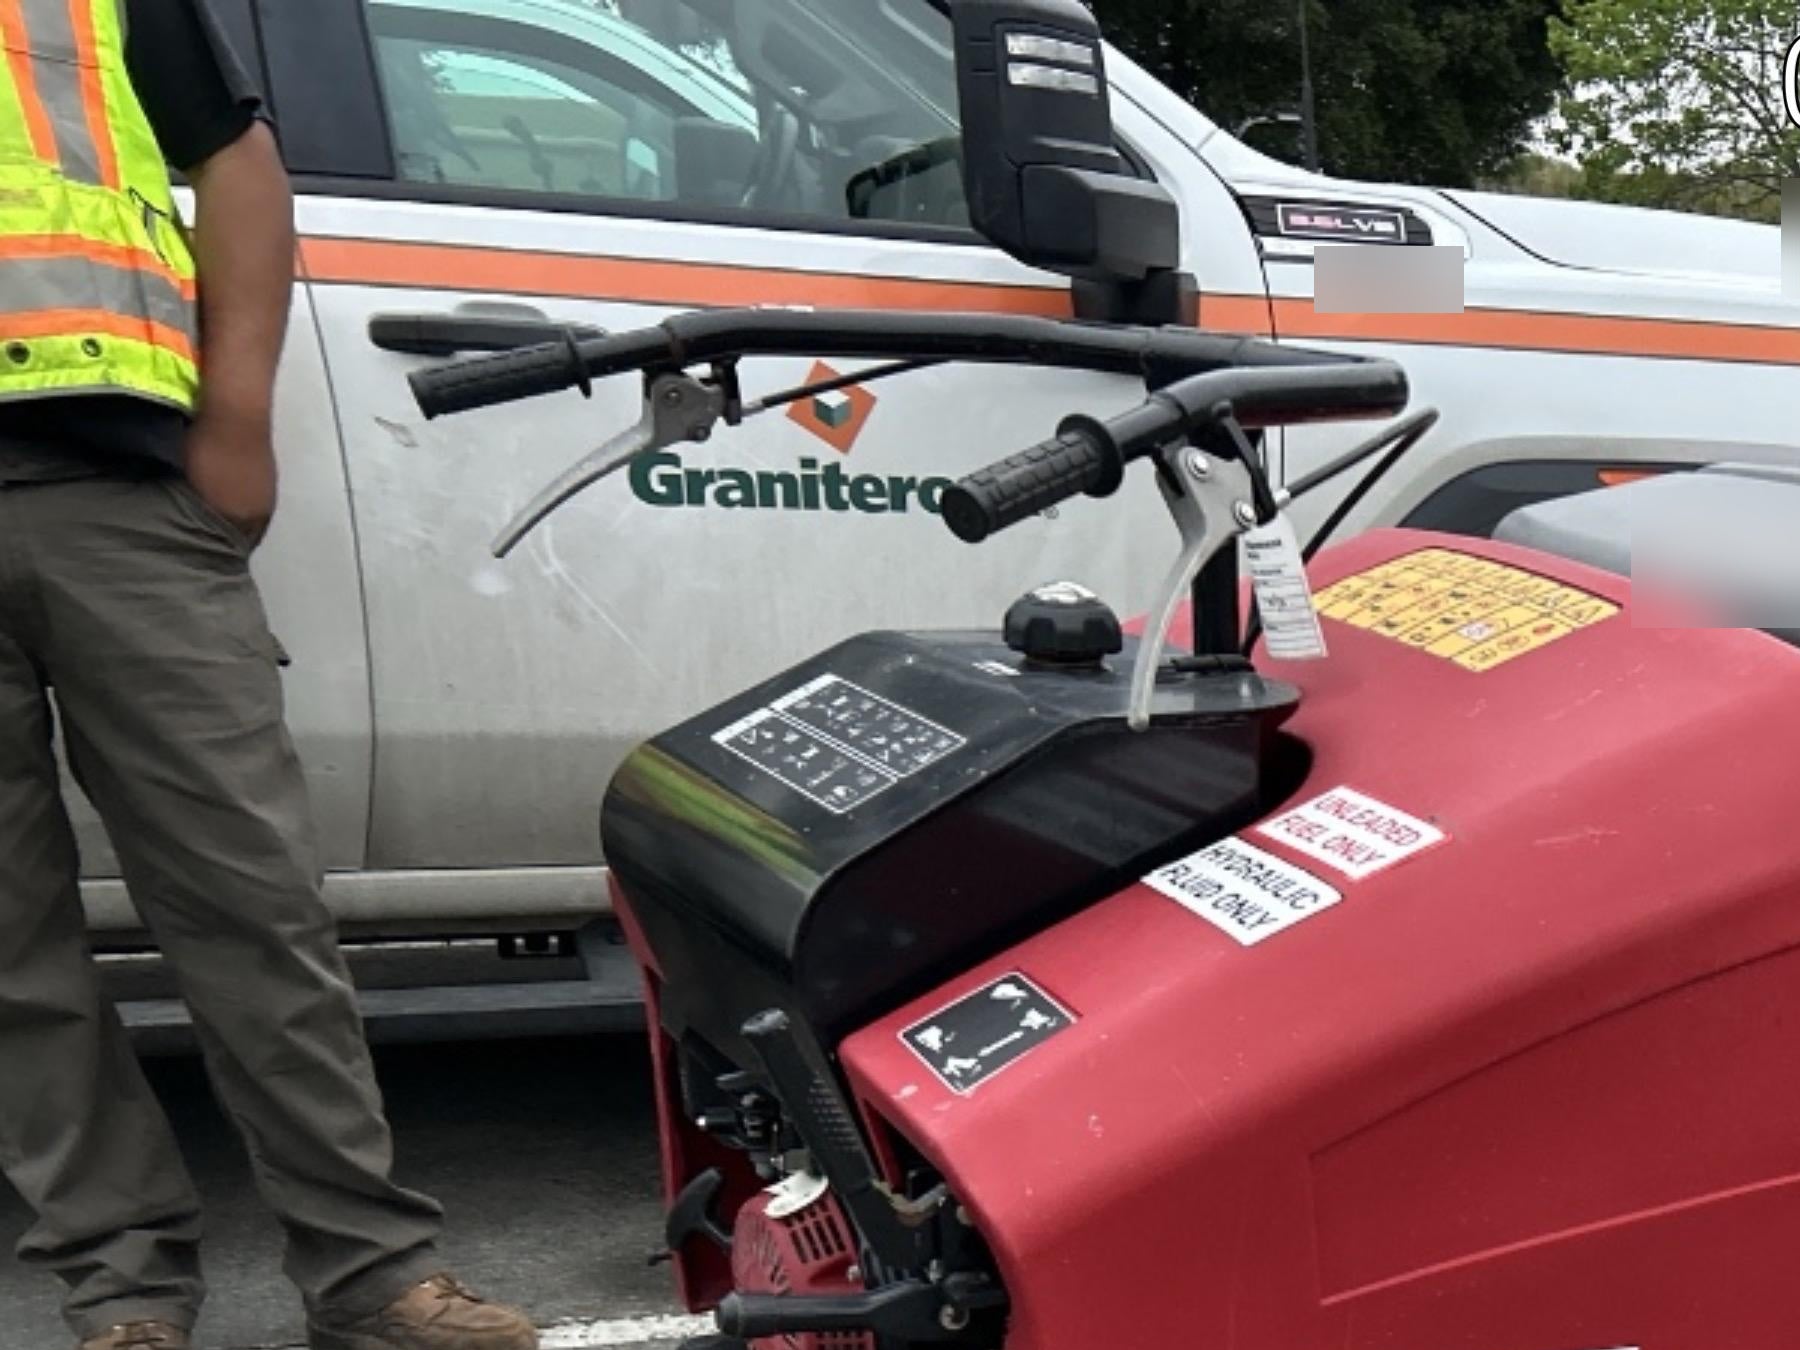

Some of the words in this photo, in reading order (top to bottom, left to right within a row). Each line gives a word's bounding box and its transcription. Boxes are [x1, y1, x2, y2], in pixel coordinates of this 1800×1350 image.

[1275, 814, 1330, 845] FUEL
[1321, 833, 1387, 866] ONLY
[1314, 795, 1422, 847] UNLEADED
[1159, 863, 1224, 898] FLUID
[1212, 890, 1279, 931] ONLY
[1199, 844, 1319, 910] HYDRAULIC
